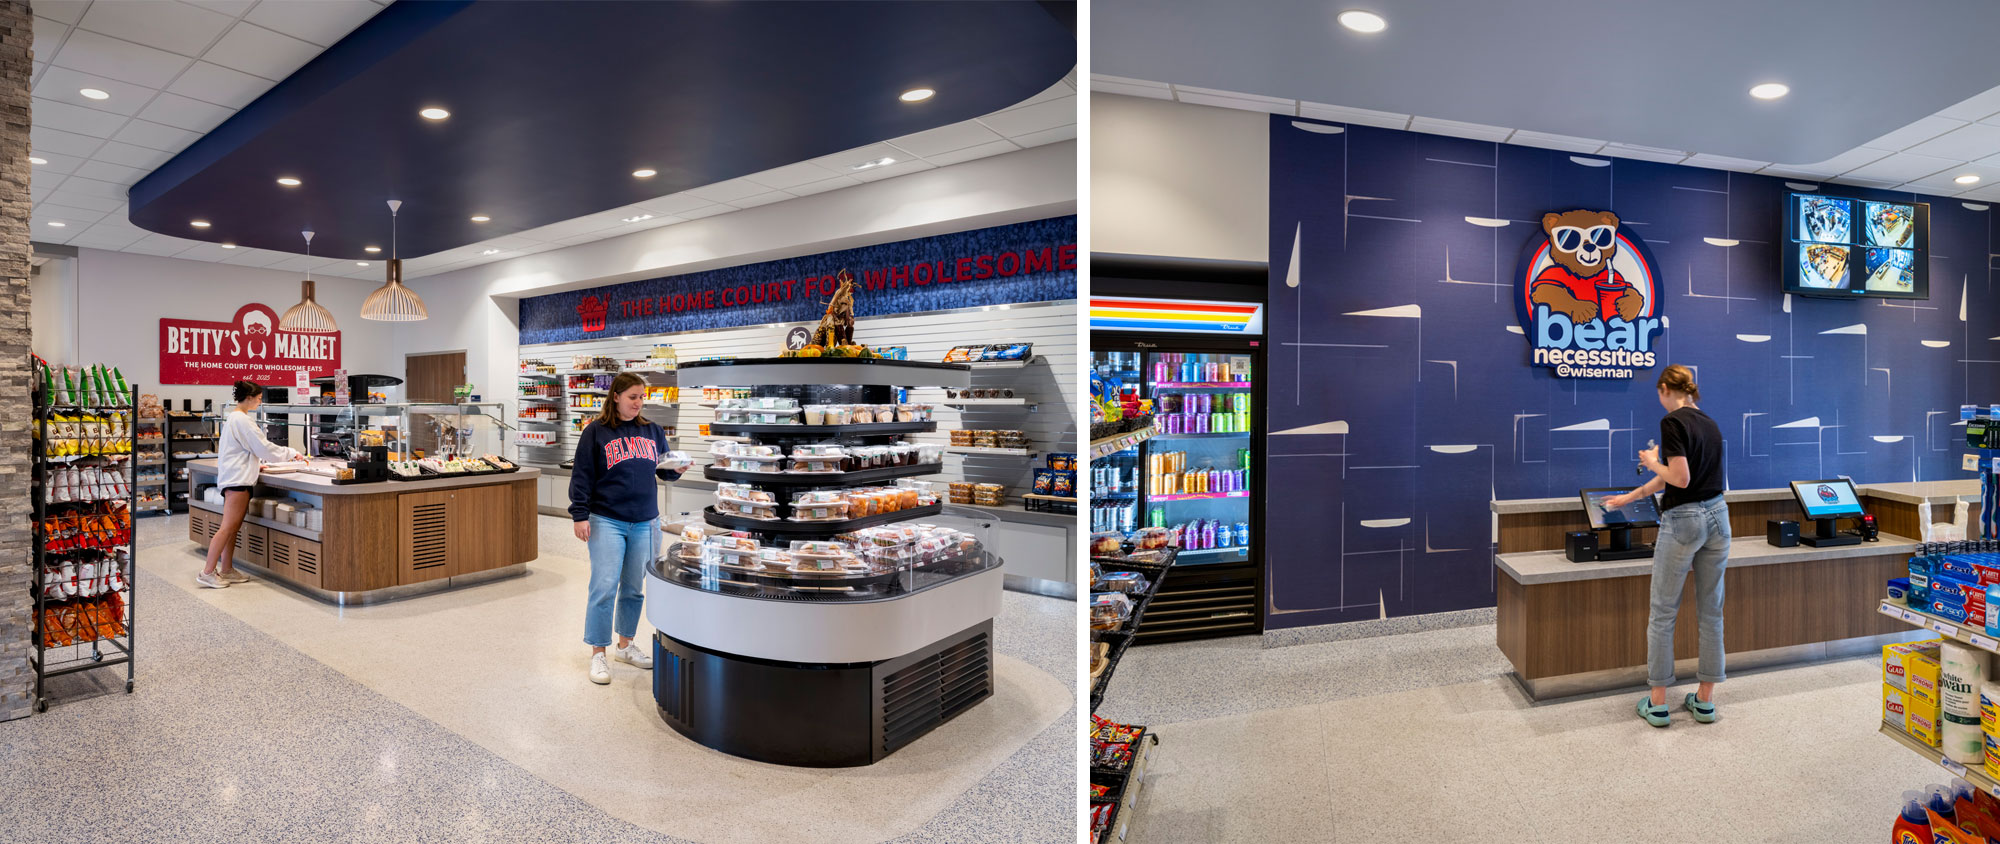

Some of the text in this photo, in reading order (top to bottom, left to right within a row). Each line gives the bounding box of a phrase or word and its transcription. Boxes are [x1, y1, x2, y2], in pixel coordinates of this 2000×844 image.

[620, 297, 653, 318] THE
[659, 289, 715, 314] HOME
[721, 279, 797, 306] COURT
[864, 243, 1077, 291] WHOLESOME
[1538, 304, 1659, 352] bear
[167, 326, 336, 360] BETTY'S MARKET
[1533, 347, 1656, 367] necessities
[201, 361, 223, 369] HOME
[224, 362, 248, 370] COURT
[250, 363, 263, 371] FOR
[264, 363, 307, 372] WHOLESOME
[1556, 364, 1633, 378] @wiseman
[604, 436, 659, 470] BELMONT
[1943, 562, 1970, 575] Crest
[1932, 582, 1958, 594] Crest
[1934, 602, 1965, 618] Crest
[1887, 664, 1904, 674] GLAD
[1911, 674, 1933, 690] STRONG
[1943, 672, 1963, 683] white
[1942, 678, 1972, 693] wan
[1887, 702, 1903, 712] GLAD
[1911, 712, 1932, 729] STRONG
